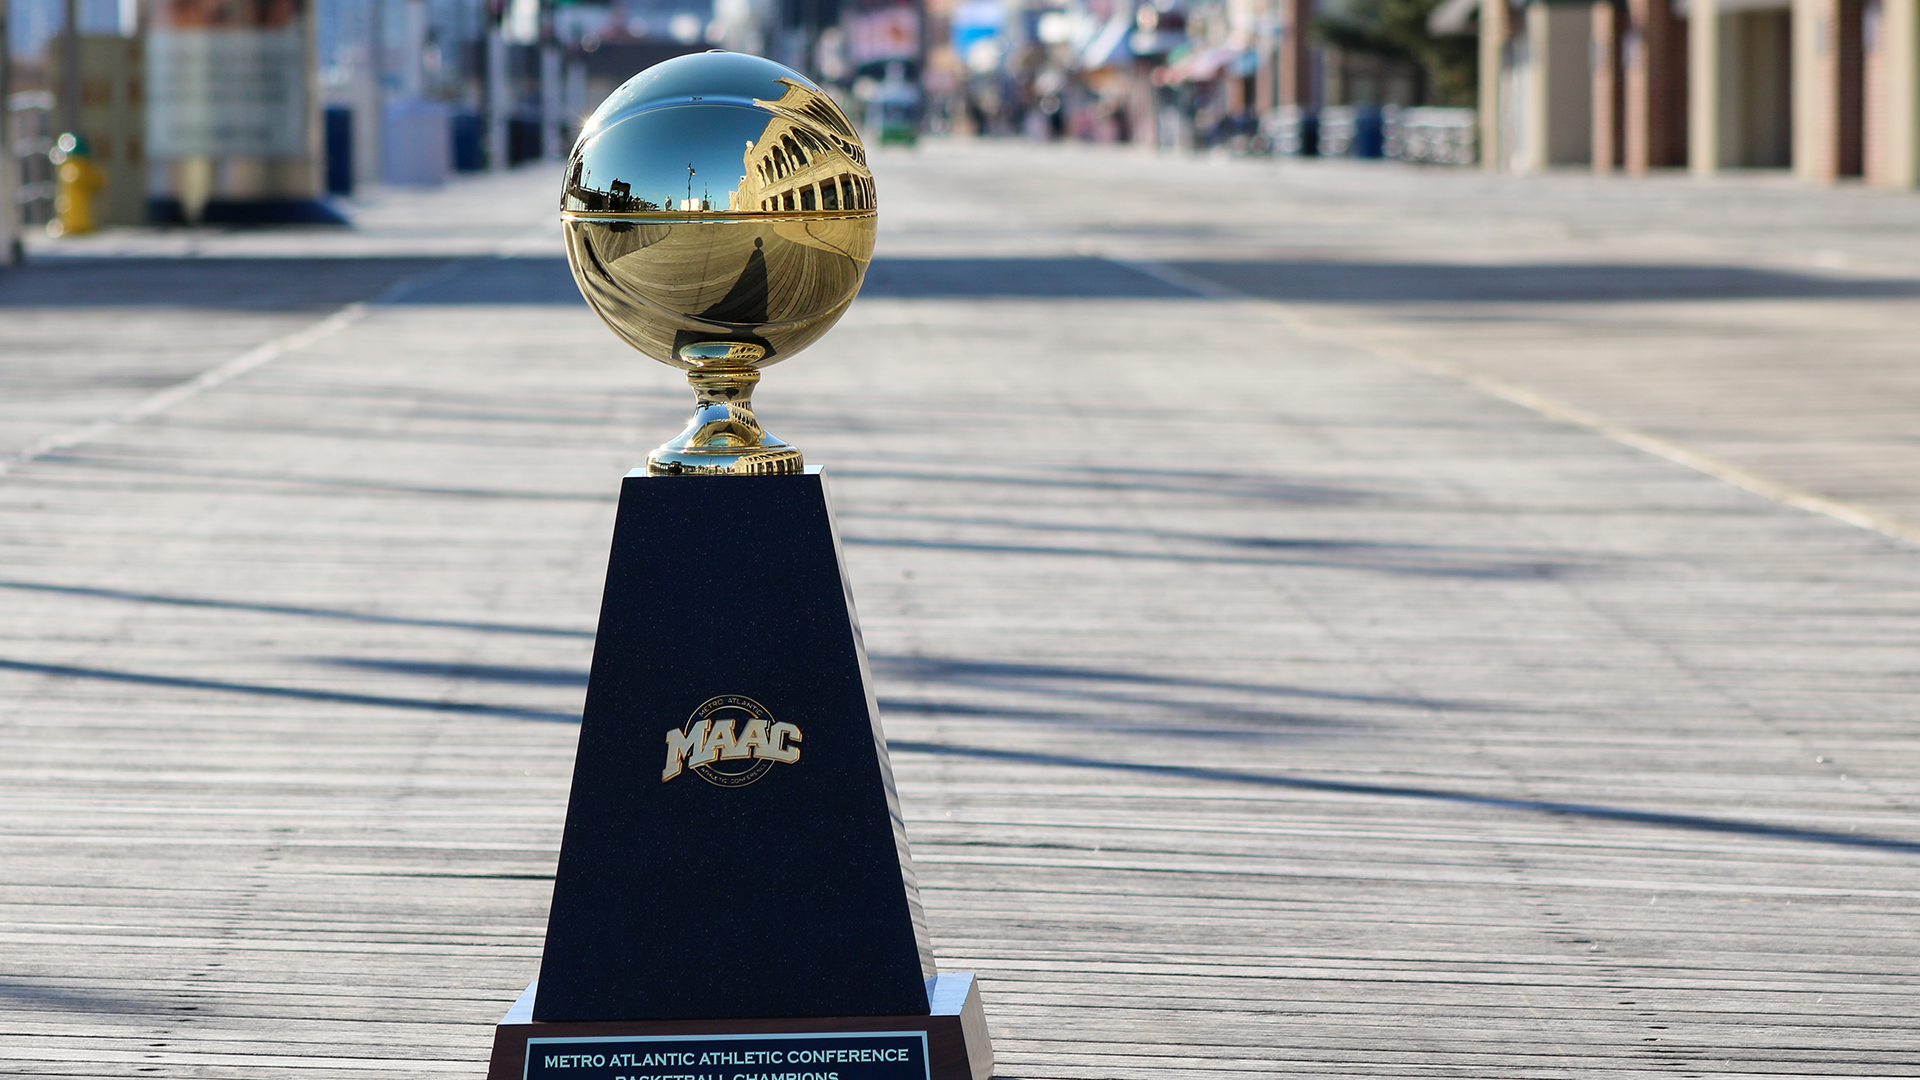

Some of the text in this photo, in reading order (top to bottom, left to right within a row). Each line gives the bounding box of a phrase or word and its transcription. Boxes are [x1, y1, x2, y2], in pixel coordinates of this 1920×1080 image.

[698, 697, 763, 717] METRO ATLANTIC
[662, 718, 803, 784] MAAC
[544, 1048, 910, 1069] METRO ATLANTIC ATHLETIC CONFERENCE
